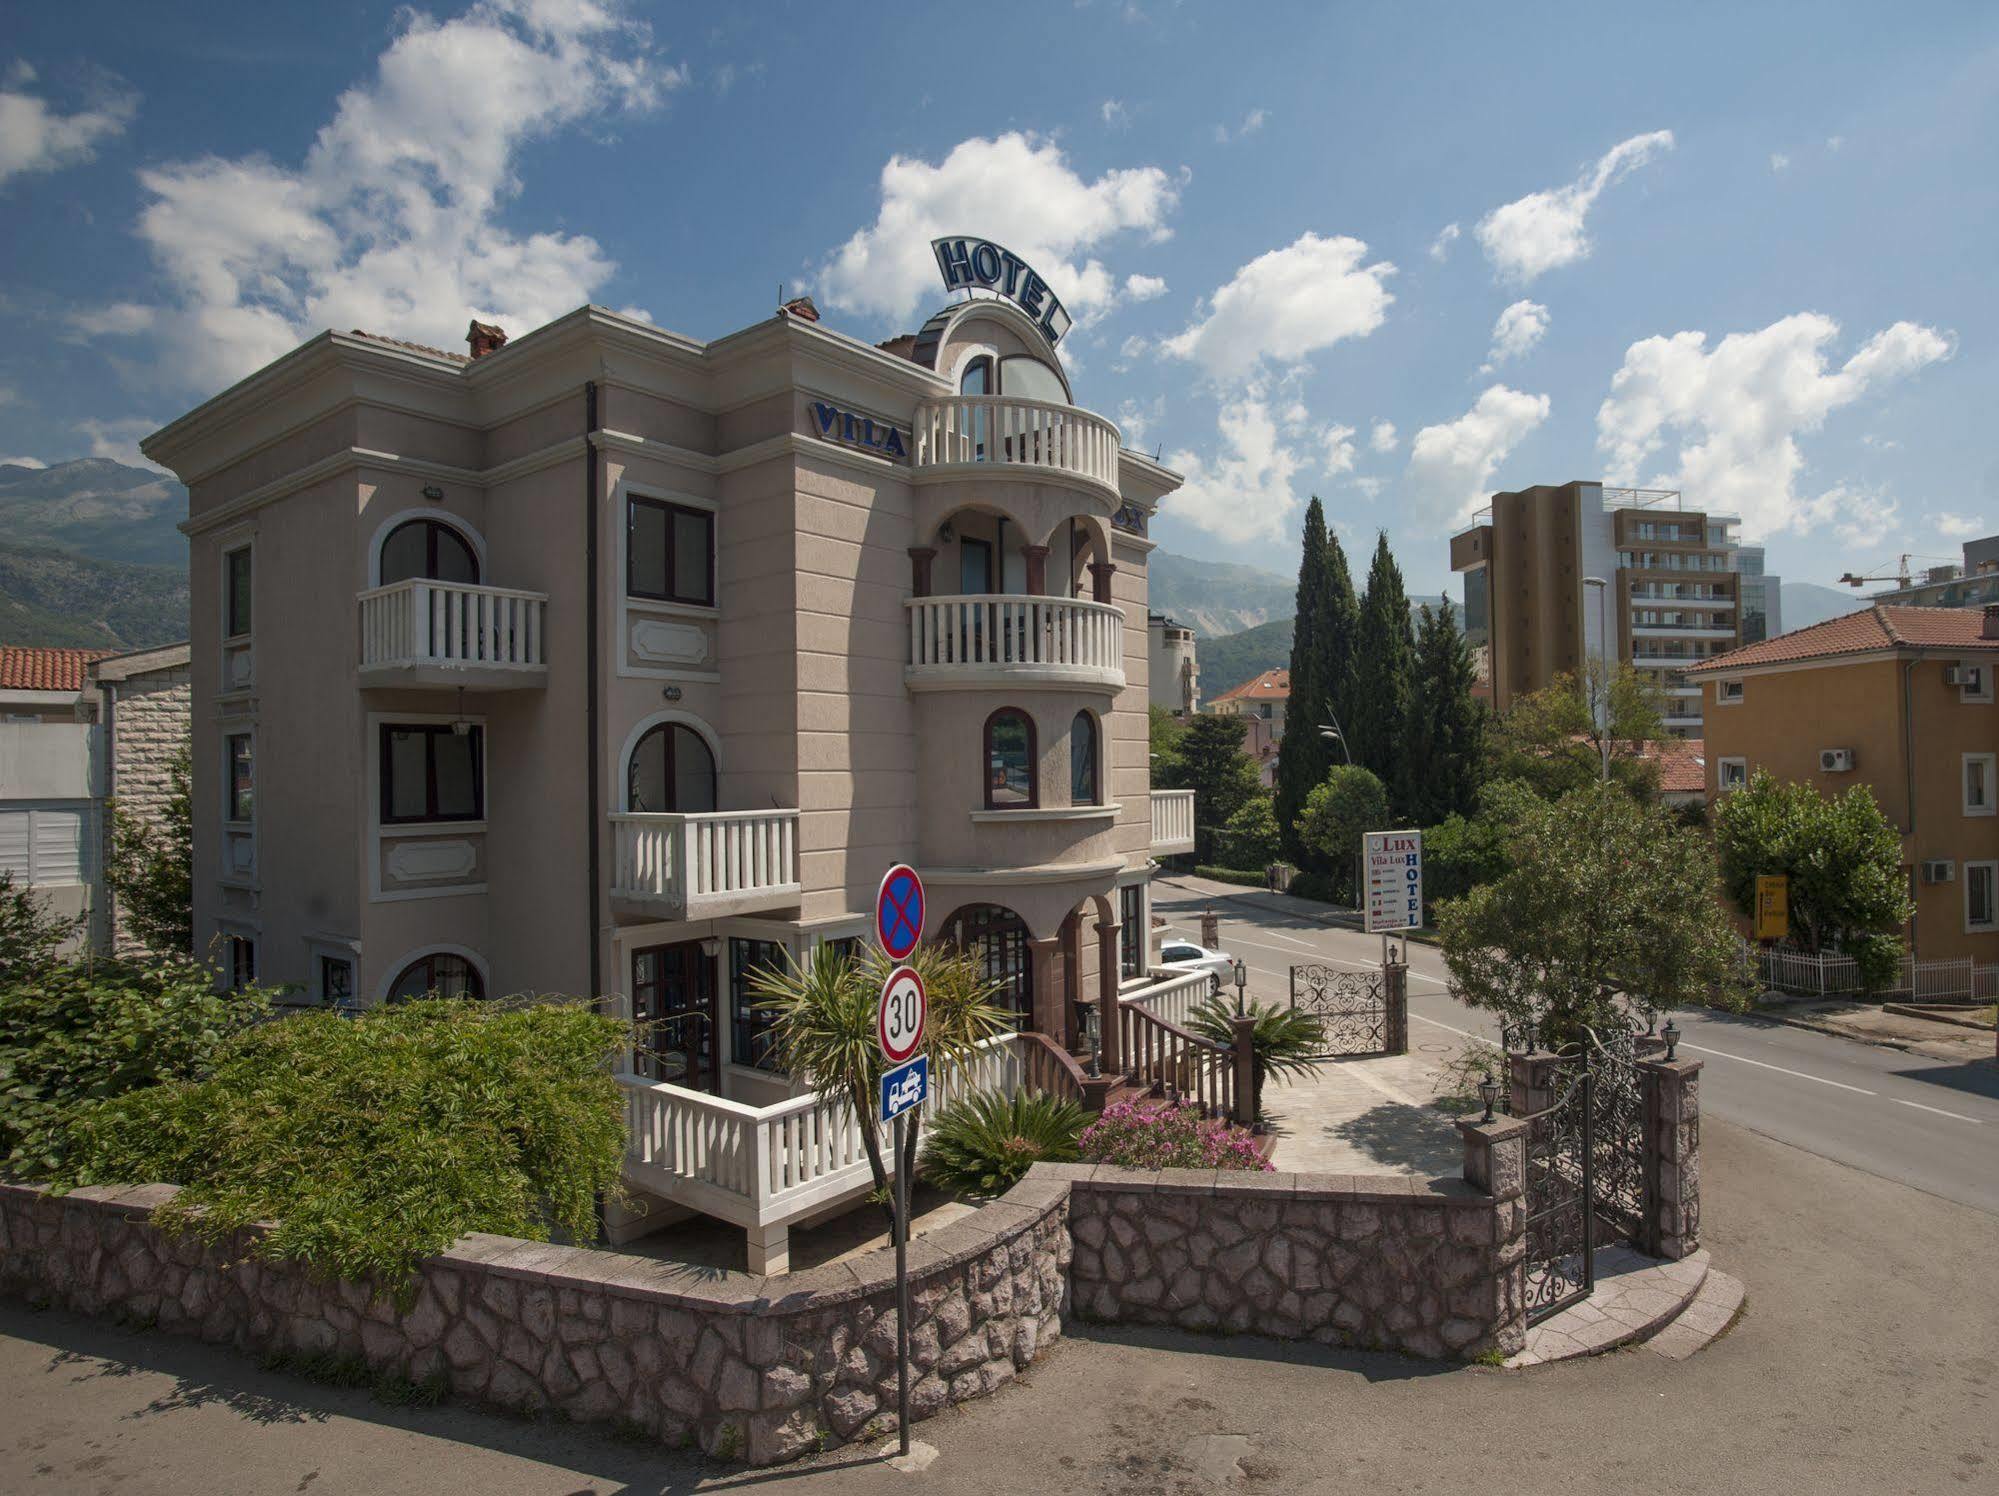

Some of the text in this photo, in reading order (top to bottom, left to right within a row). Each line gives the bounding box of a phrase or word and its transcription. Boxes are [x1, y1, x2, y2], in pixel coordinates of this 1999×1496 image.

[938, 240, 1059, 342] HOTEL
[811, 402, 908, 457] VILA
[1371, 855, 1406, 865] Vila Lux
[1383, 837, 1416, 852] Lux
[1405, 854, 1418, 926] HOTEL
[890, 990, 916, 1039] 30
